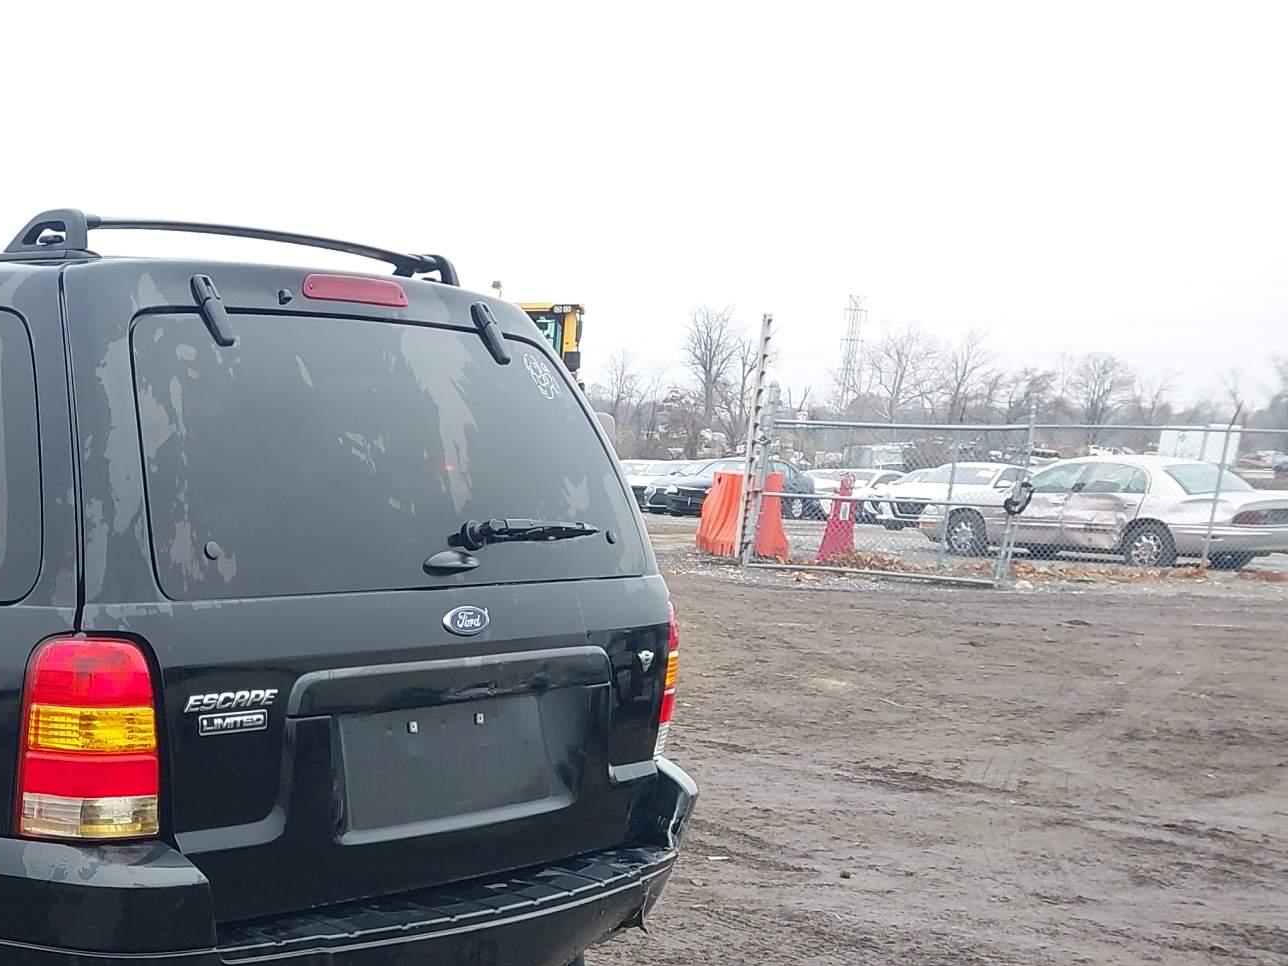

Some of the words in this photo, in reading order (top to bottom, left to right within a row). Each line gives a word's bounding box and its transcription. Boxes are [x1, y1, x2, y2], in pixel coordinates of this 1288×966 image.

[457, 611, 481, 628] Ford
[184, 689, 278, 713] ESCAPE
[202, 714, 265, 731] LIMITED
